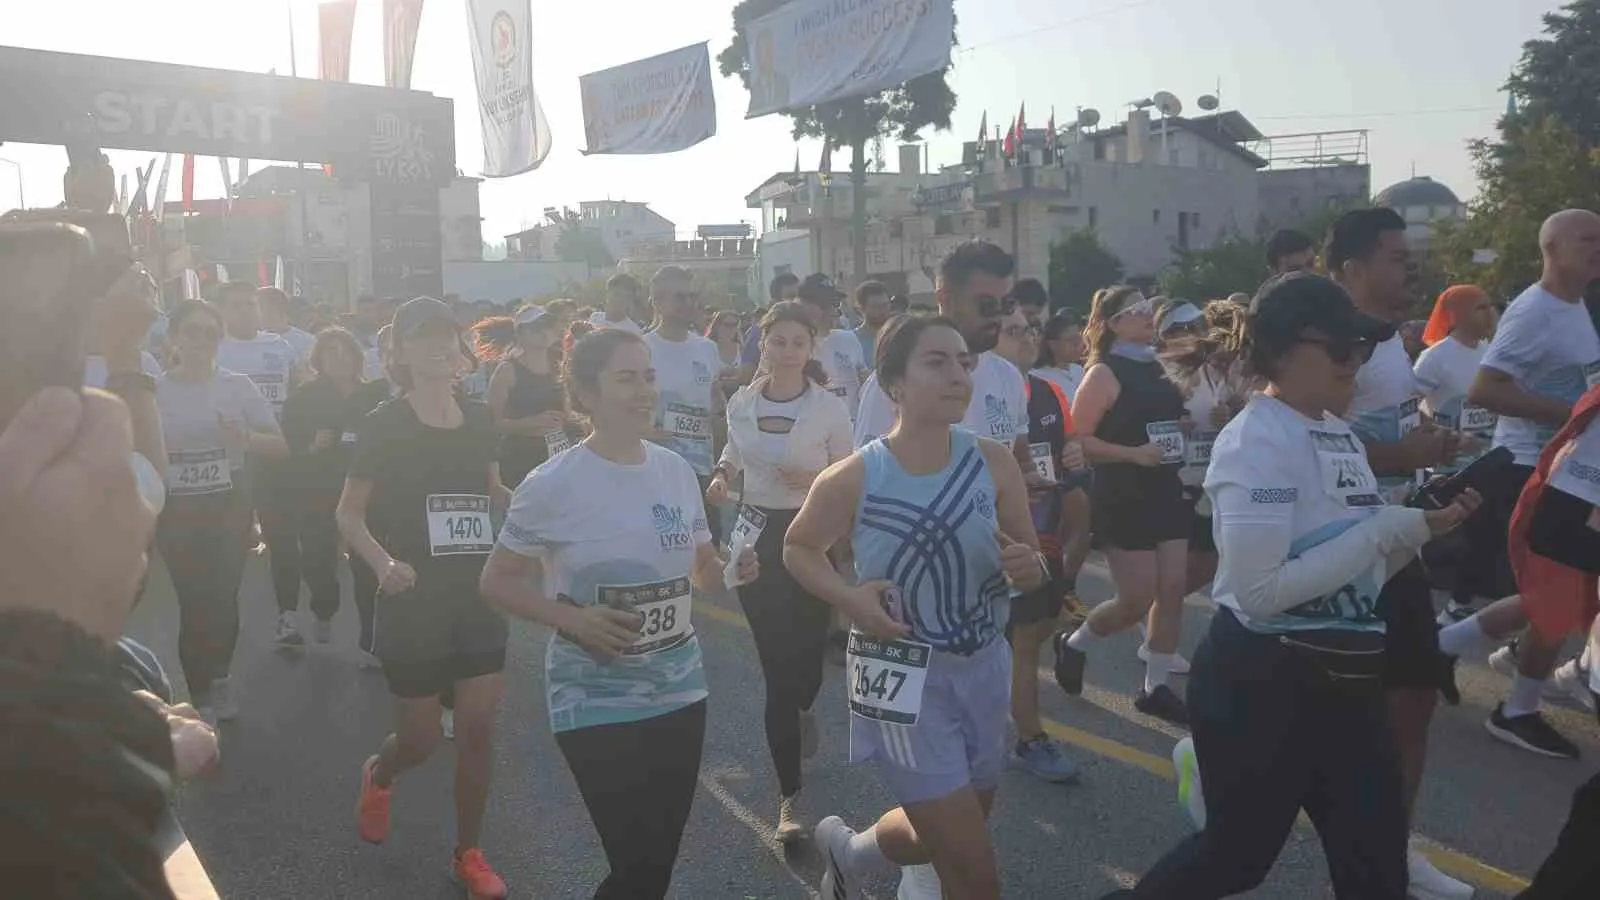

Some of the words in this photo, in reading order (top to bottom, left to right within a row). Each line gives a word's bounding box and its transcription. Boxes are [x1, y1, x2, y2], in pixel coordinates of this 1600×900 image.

[801, 7, 830, 34] WISH
[96, 90, 281, 145] START
[179, 463, 221, 484] 4342
[446, 516, 482, 539] 1470
[886, 645, 902, 658] 5K
[855, 663, 907, 702] 2647
